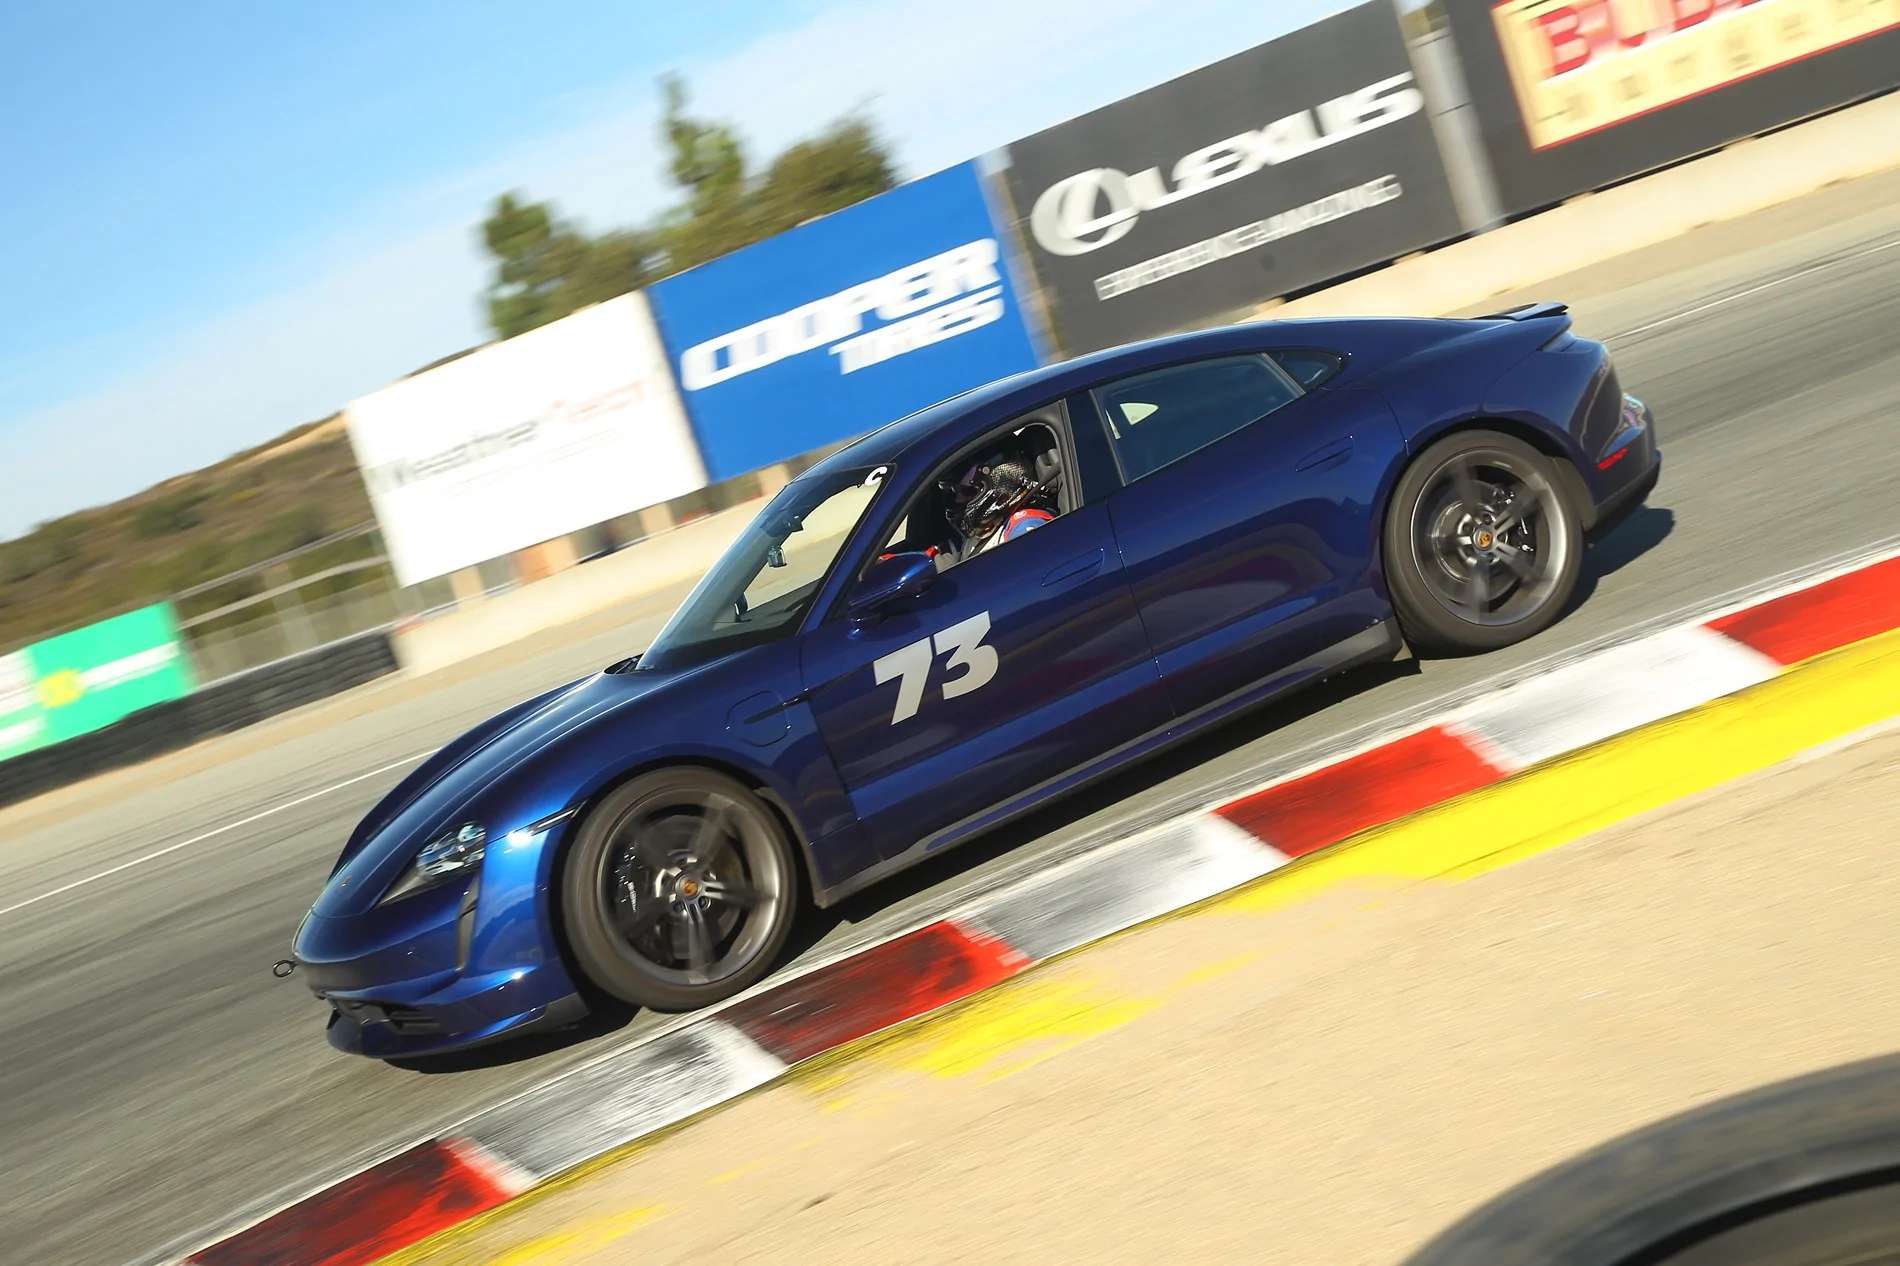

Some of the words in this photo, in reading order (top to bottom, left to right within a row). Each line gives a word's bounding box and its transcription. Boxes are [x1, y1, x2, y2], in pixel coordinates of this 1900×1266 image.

[1124, 71, 1424, 212] LEXUS
[680, 238, 1001, 392] COOPER
[873, 610, 999, 726] 73
